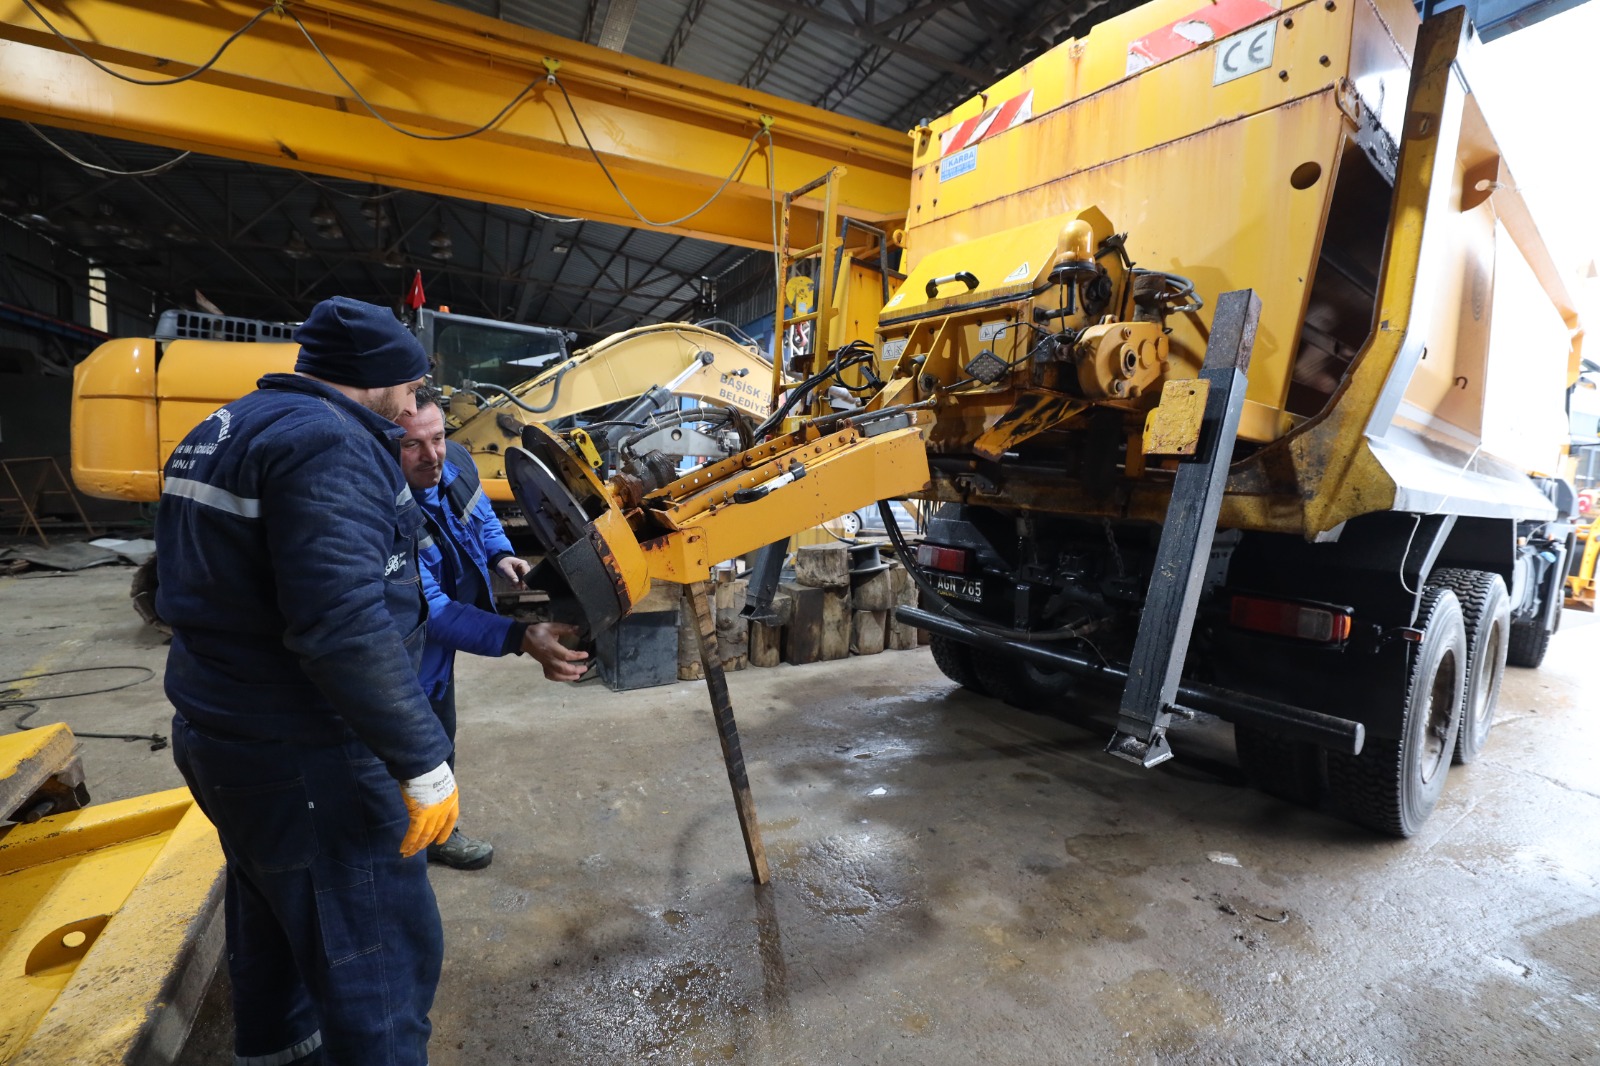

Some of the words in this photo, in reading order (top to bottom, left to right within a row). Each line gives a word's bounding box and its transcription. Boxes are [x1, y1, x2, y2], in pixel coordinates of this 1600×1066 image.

[1223, 30, 1267, 73] CE
[948, 151, 974, 168] KARBA
[937, 577, 956, 593] AGN
[961, 580, 982, 597] 765
